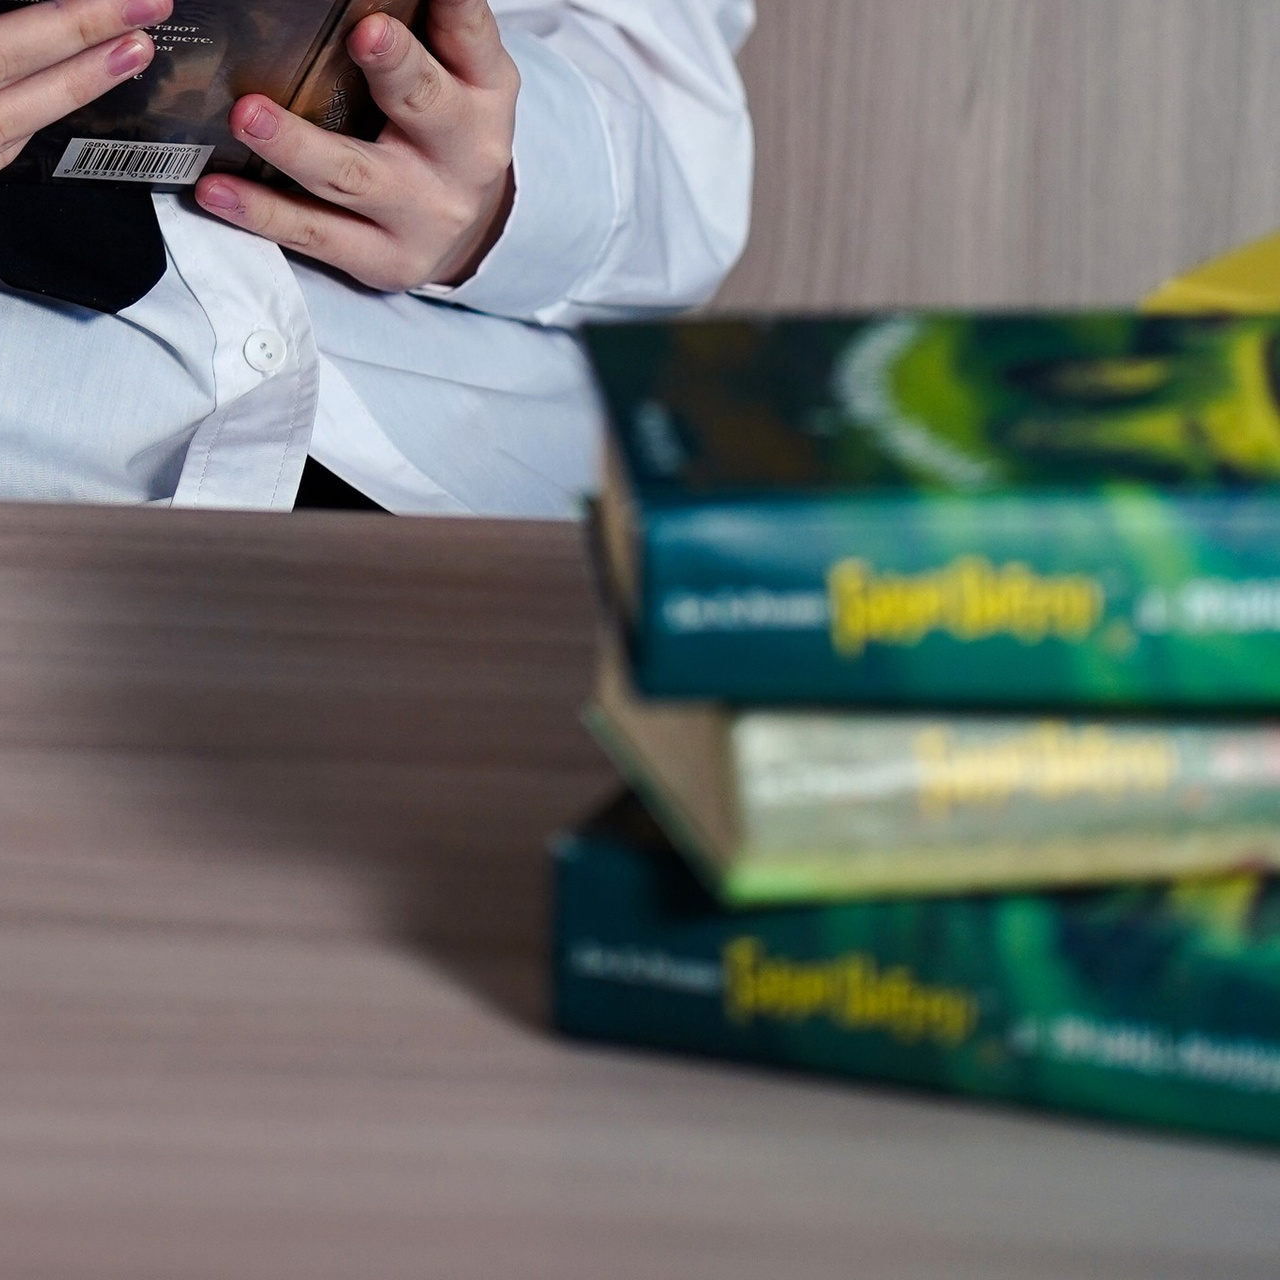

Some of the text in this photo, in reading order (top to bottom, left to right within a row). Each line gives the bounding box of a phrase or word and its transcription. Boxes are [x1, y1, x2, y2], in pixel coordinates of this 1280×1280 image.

[162, 33, 214, 45] свете.
[83, 141, 202, 154] ISBN 978-5-353-02907-6
